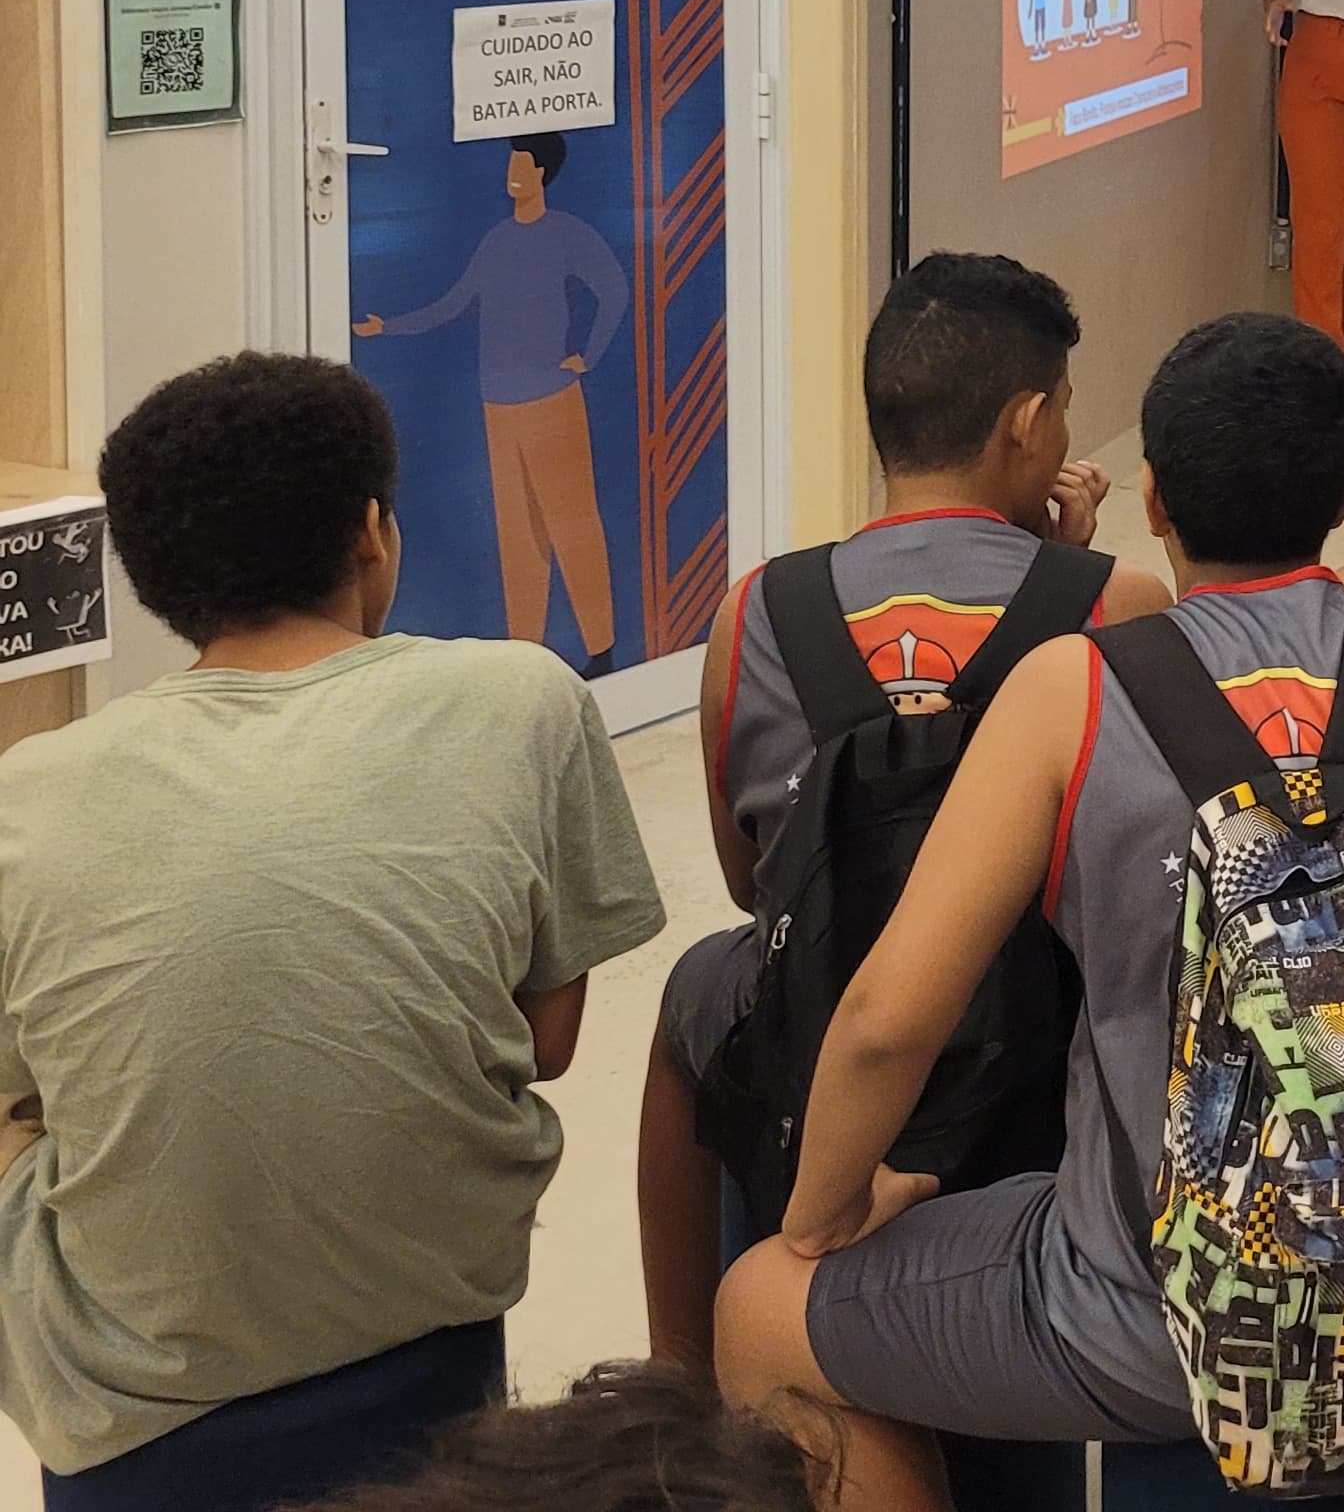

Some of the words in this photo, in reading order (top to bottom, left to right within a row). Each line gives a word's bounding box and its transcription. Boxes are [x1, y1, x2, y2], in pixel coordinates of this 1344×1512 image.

[481, 32, 563, 56] CUIDADO
[568, 30, 593, 47] AO
[493, 68, 538, 87] SAIR,
[543, 60, 582, 82] NÃO
[473, 100, 520, 121] BATA
[524, 99, 536, 115] A
[542, 91, 603, 113] PORTA.
[1283, 957, 1311, 969] CLIO
